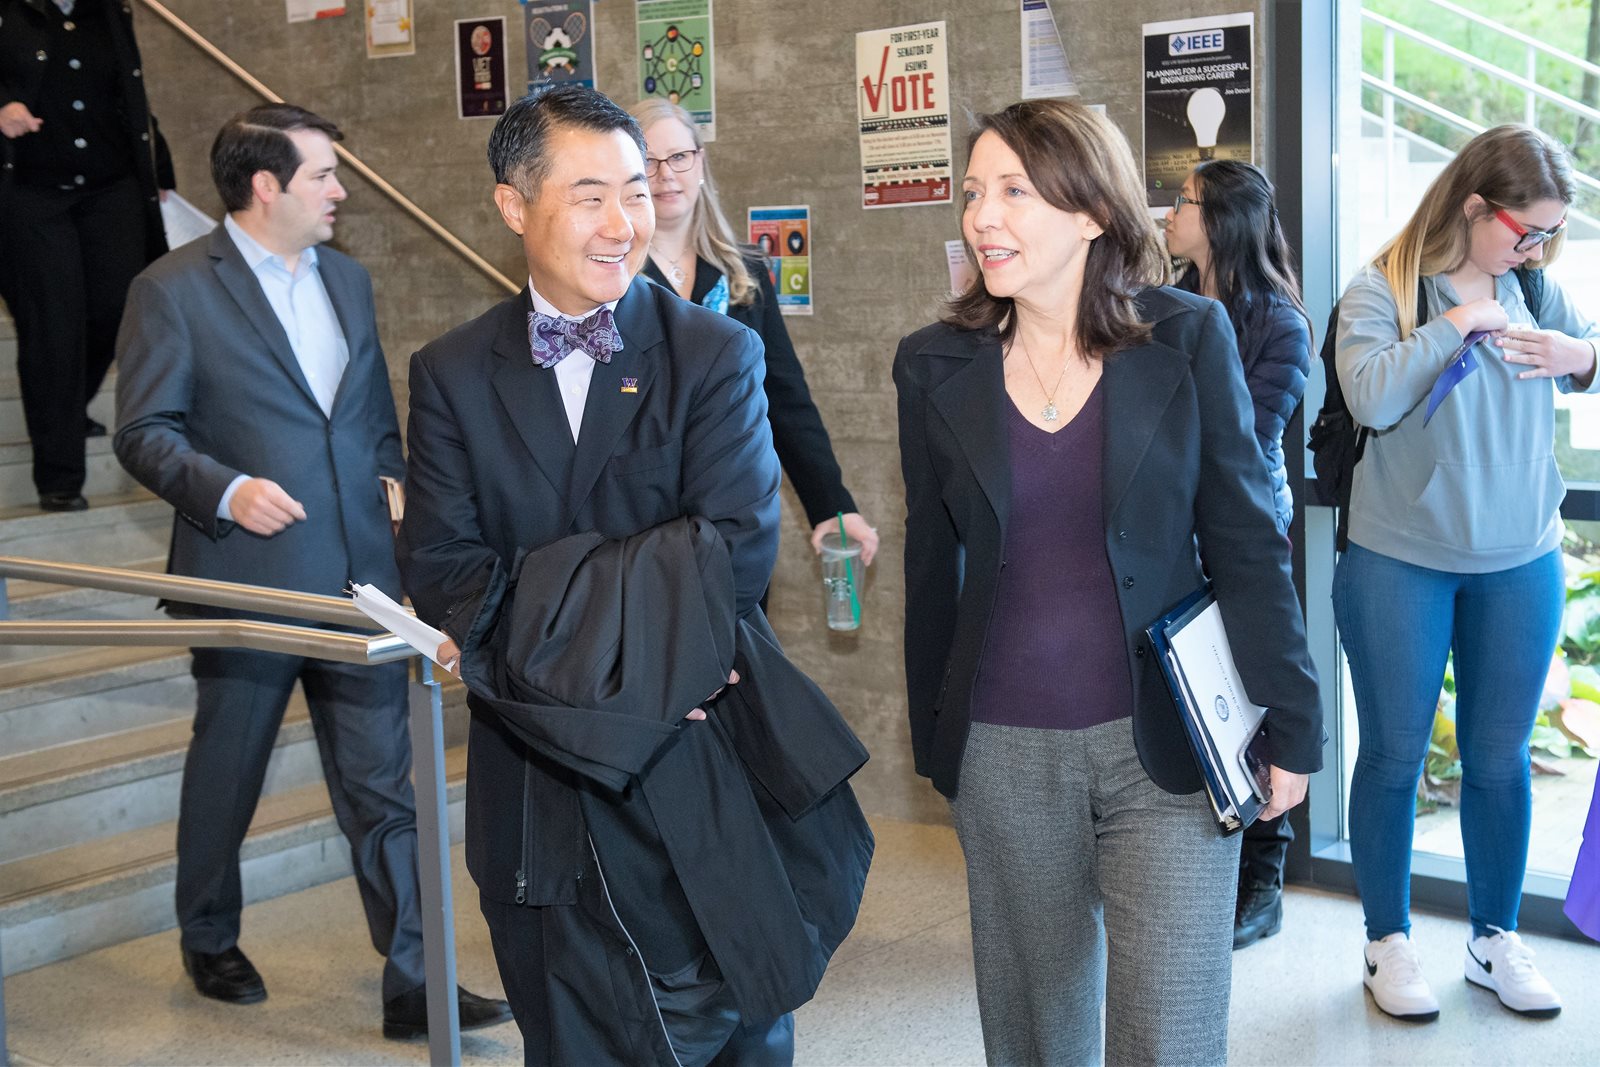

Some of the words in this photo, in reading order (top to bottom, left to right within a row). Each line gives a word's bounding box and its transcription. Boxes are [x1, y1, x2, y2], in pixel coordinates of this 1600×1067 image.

[890, 33, 902, 43] FOR
[904, 28, 939, 42] FIRST-YEAR
[1187, 33, 1222, 50] IEEE
[897, 45, 924, 58] SENATOR
[926, 44, 933, 54] OF
[1146, 67, 1182, 79] PLANNING
[1183, 66, 1196, 75] FOR
[1203, 62, 1249, 73] SUCCESSFUL
[1160, 74, 1206, 85] ENGINEERING
[1207, 70, 1235, 80] CAREER
